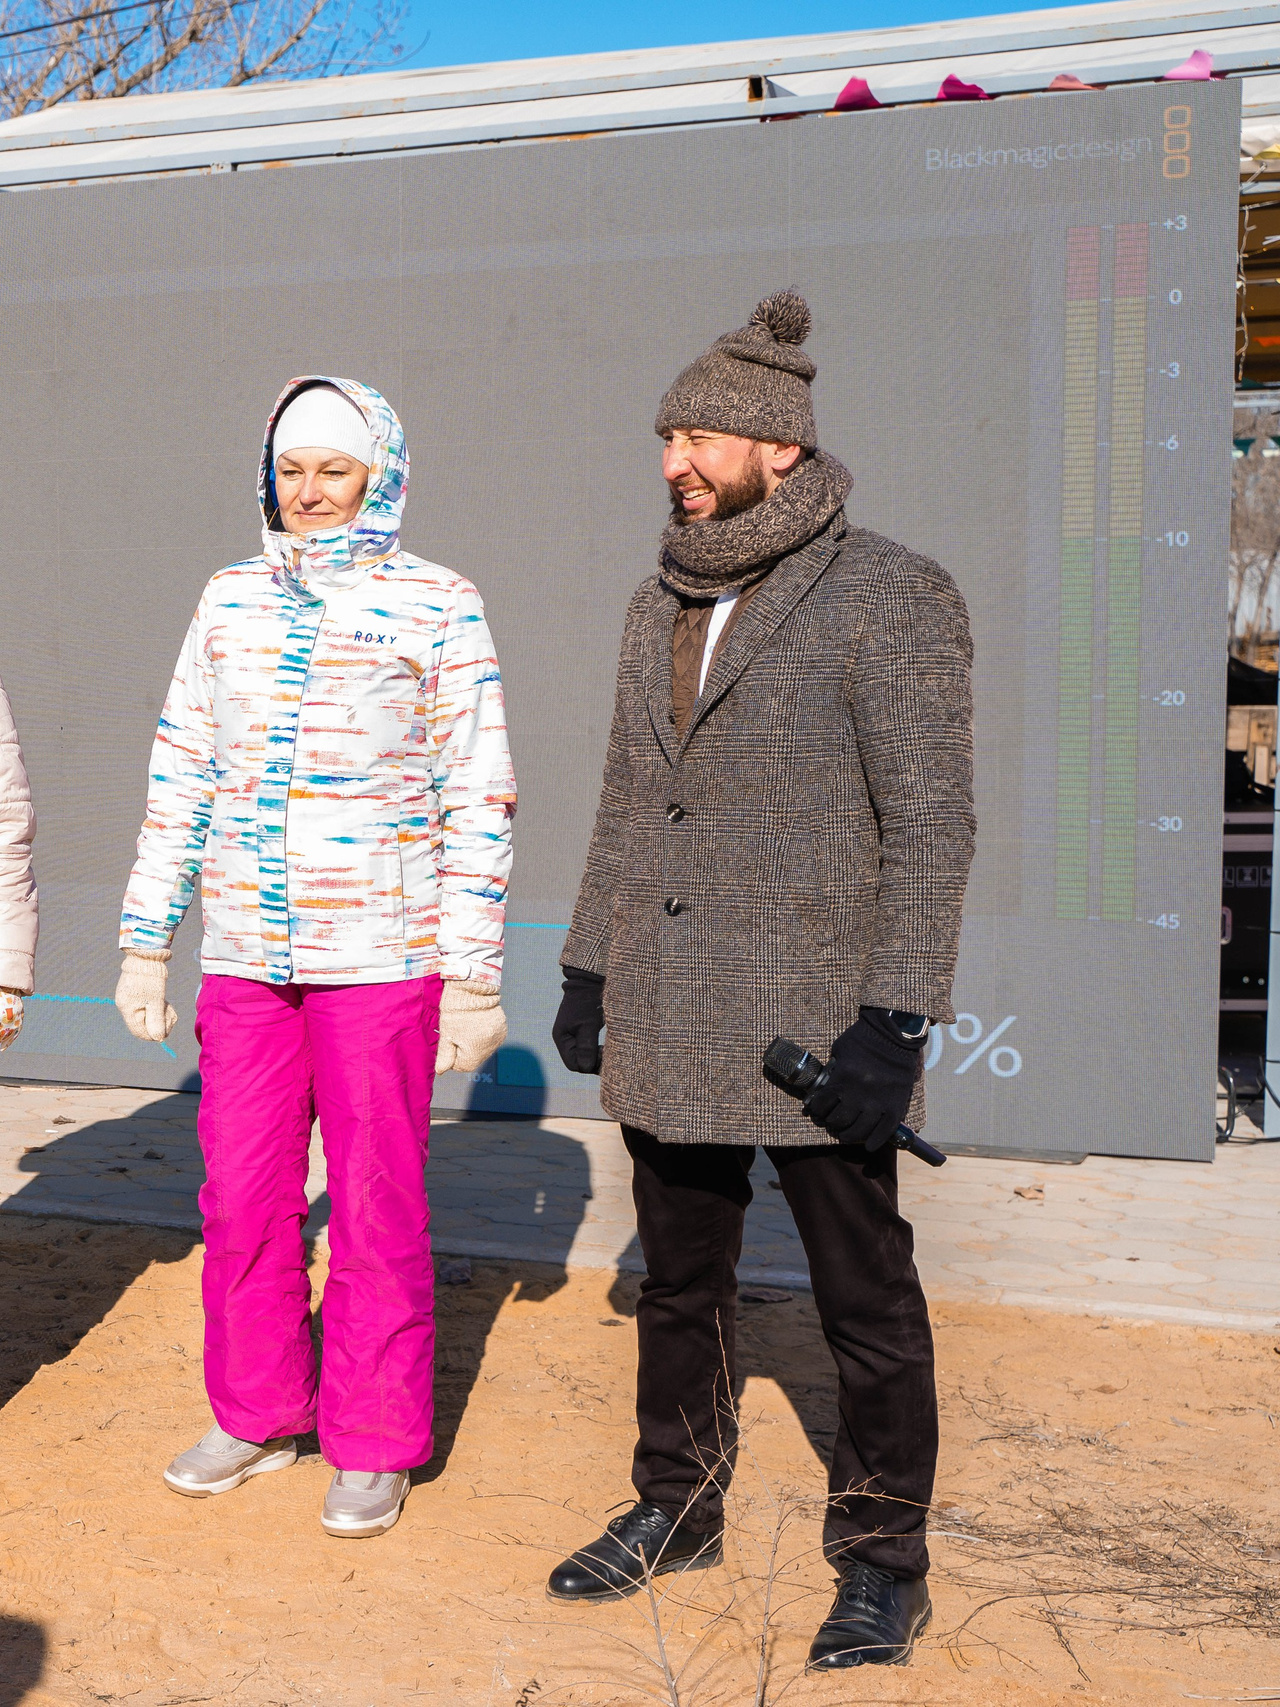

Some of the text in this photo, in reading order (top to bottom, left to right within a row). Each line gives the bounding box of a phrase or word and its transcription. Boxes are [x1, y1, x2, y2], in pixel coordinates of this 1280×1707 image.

[1163, 215, 1188, 231] +3
[1159, 361, 1180, 379] -3
[1158, 434, 1179, 451] -6
[1155, 530, 1189, 548] -10
[353, 630, 398, 645] ROXY
[1152, 690, 1186, 707] -20
[1150, 815, 1183, 833] -30
[1147, 913, 1181, 930] -45
